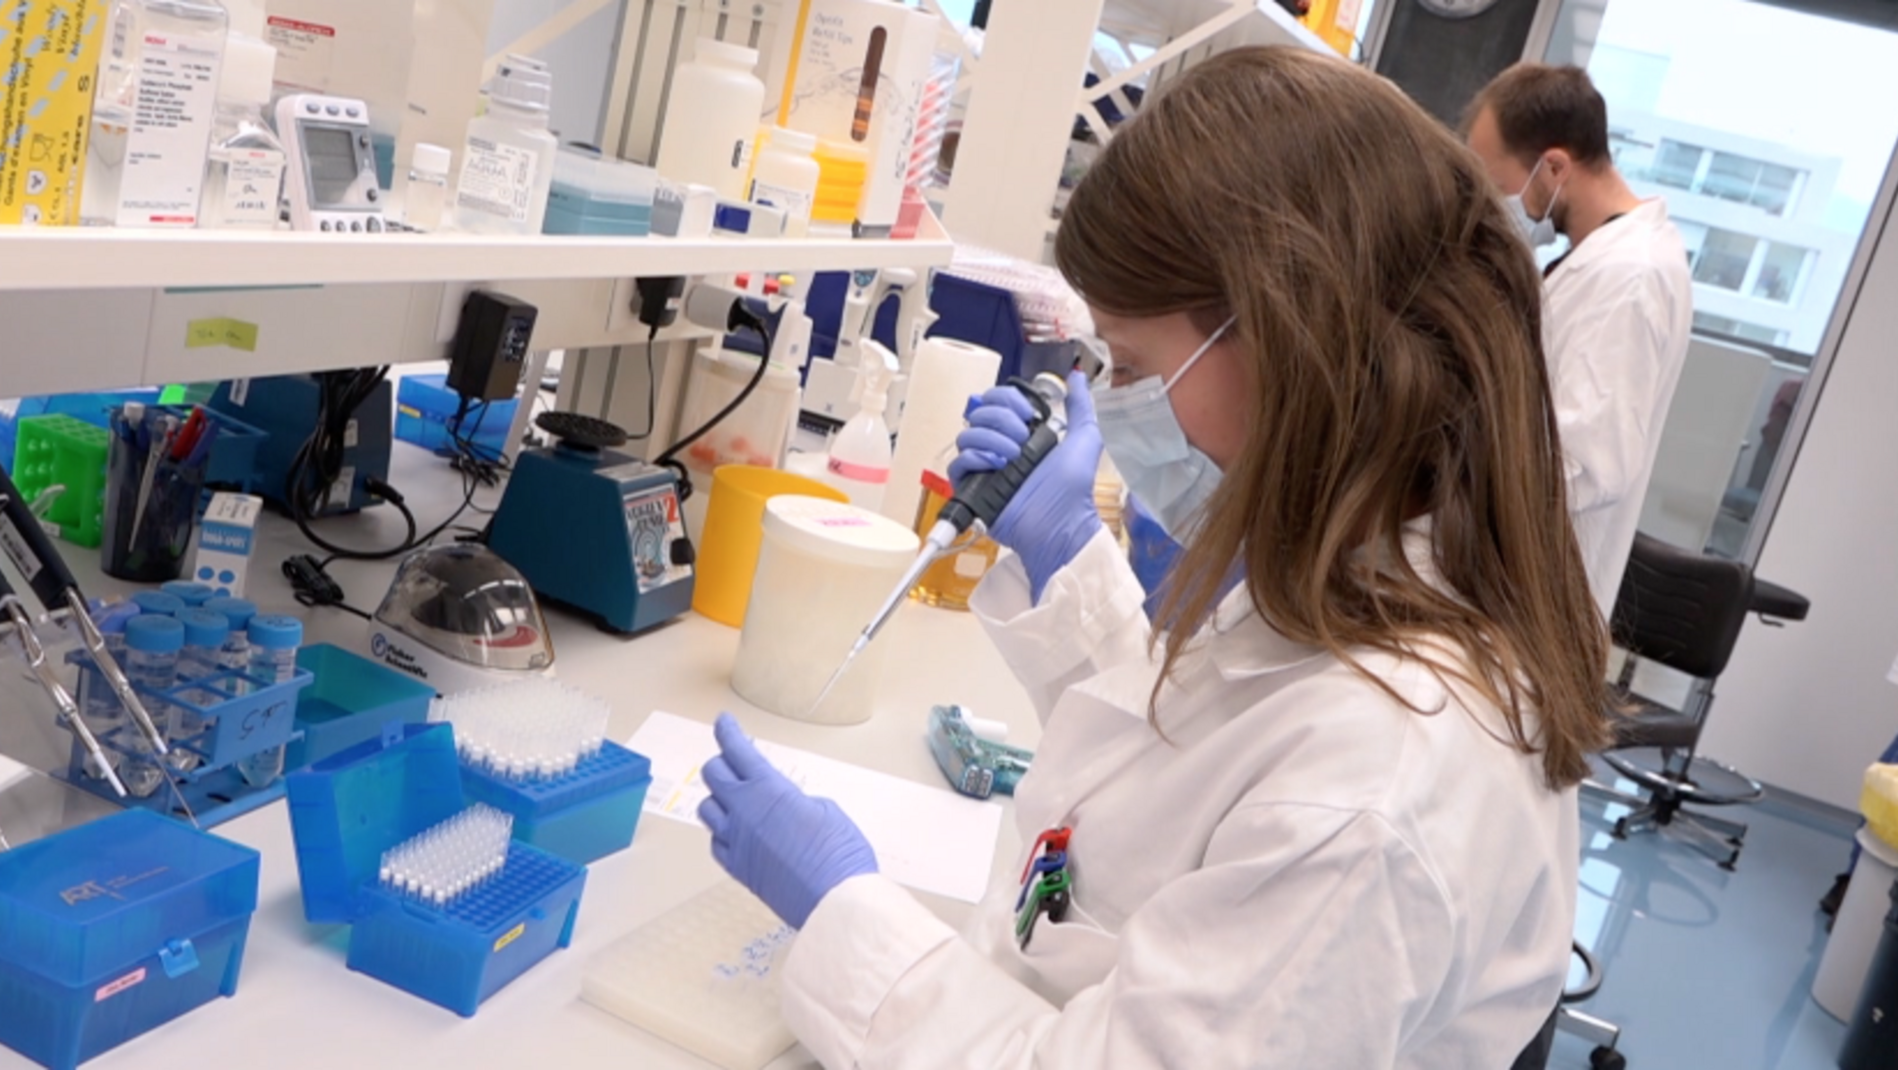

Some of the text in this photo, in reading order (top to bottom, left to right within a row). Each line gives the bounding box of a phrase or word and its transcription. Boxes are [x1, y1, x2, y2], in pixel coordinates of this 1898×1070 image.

[20, 57, 34, 89] Vinyl
[77, 75, 90, 93] S
[387, 643, 415, 662] Fisher
[385, 654, 428, 679] Scientific
